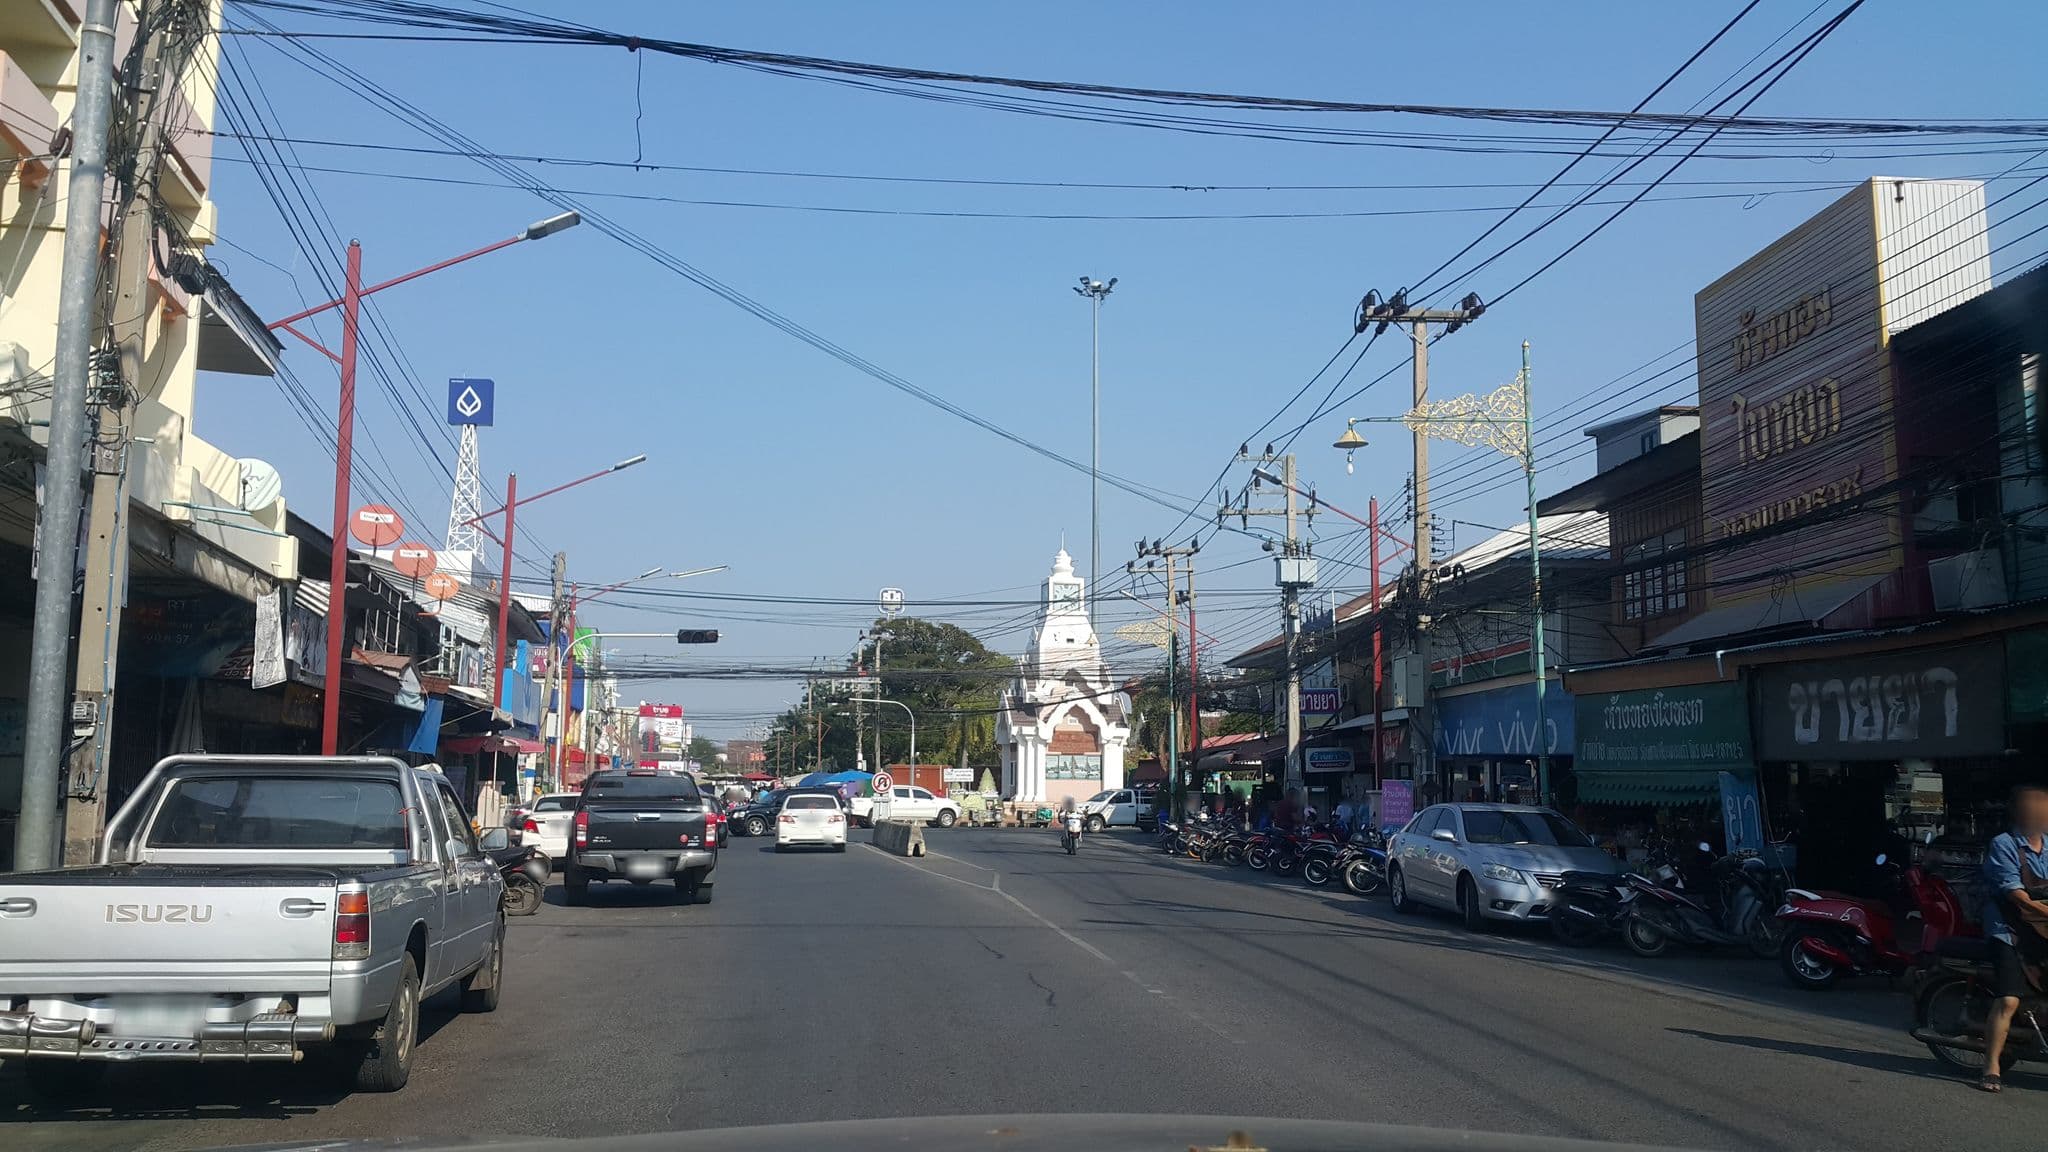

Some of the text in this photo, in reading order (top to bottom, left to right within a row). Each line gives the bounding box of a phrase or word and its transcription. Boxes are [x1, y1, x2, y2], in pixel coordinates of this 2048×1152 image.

[1731, 376, 1842, 469] ใบหยก
[652, 706, 670, 714] true
[1788, 666, 1959, 744] ขายยา
[104, 903, 213, 925] ISUZU
